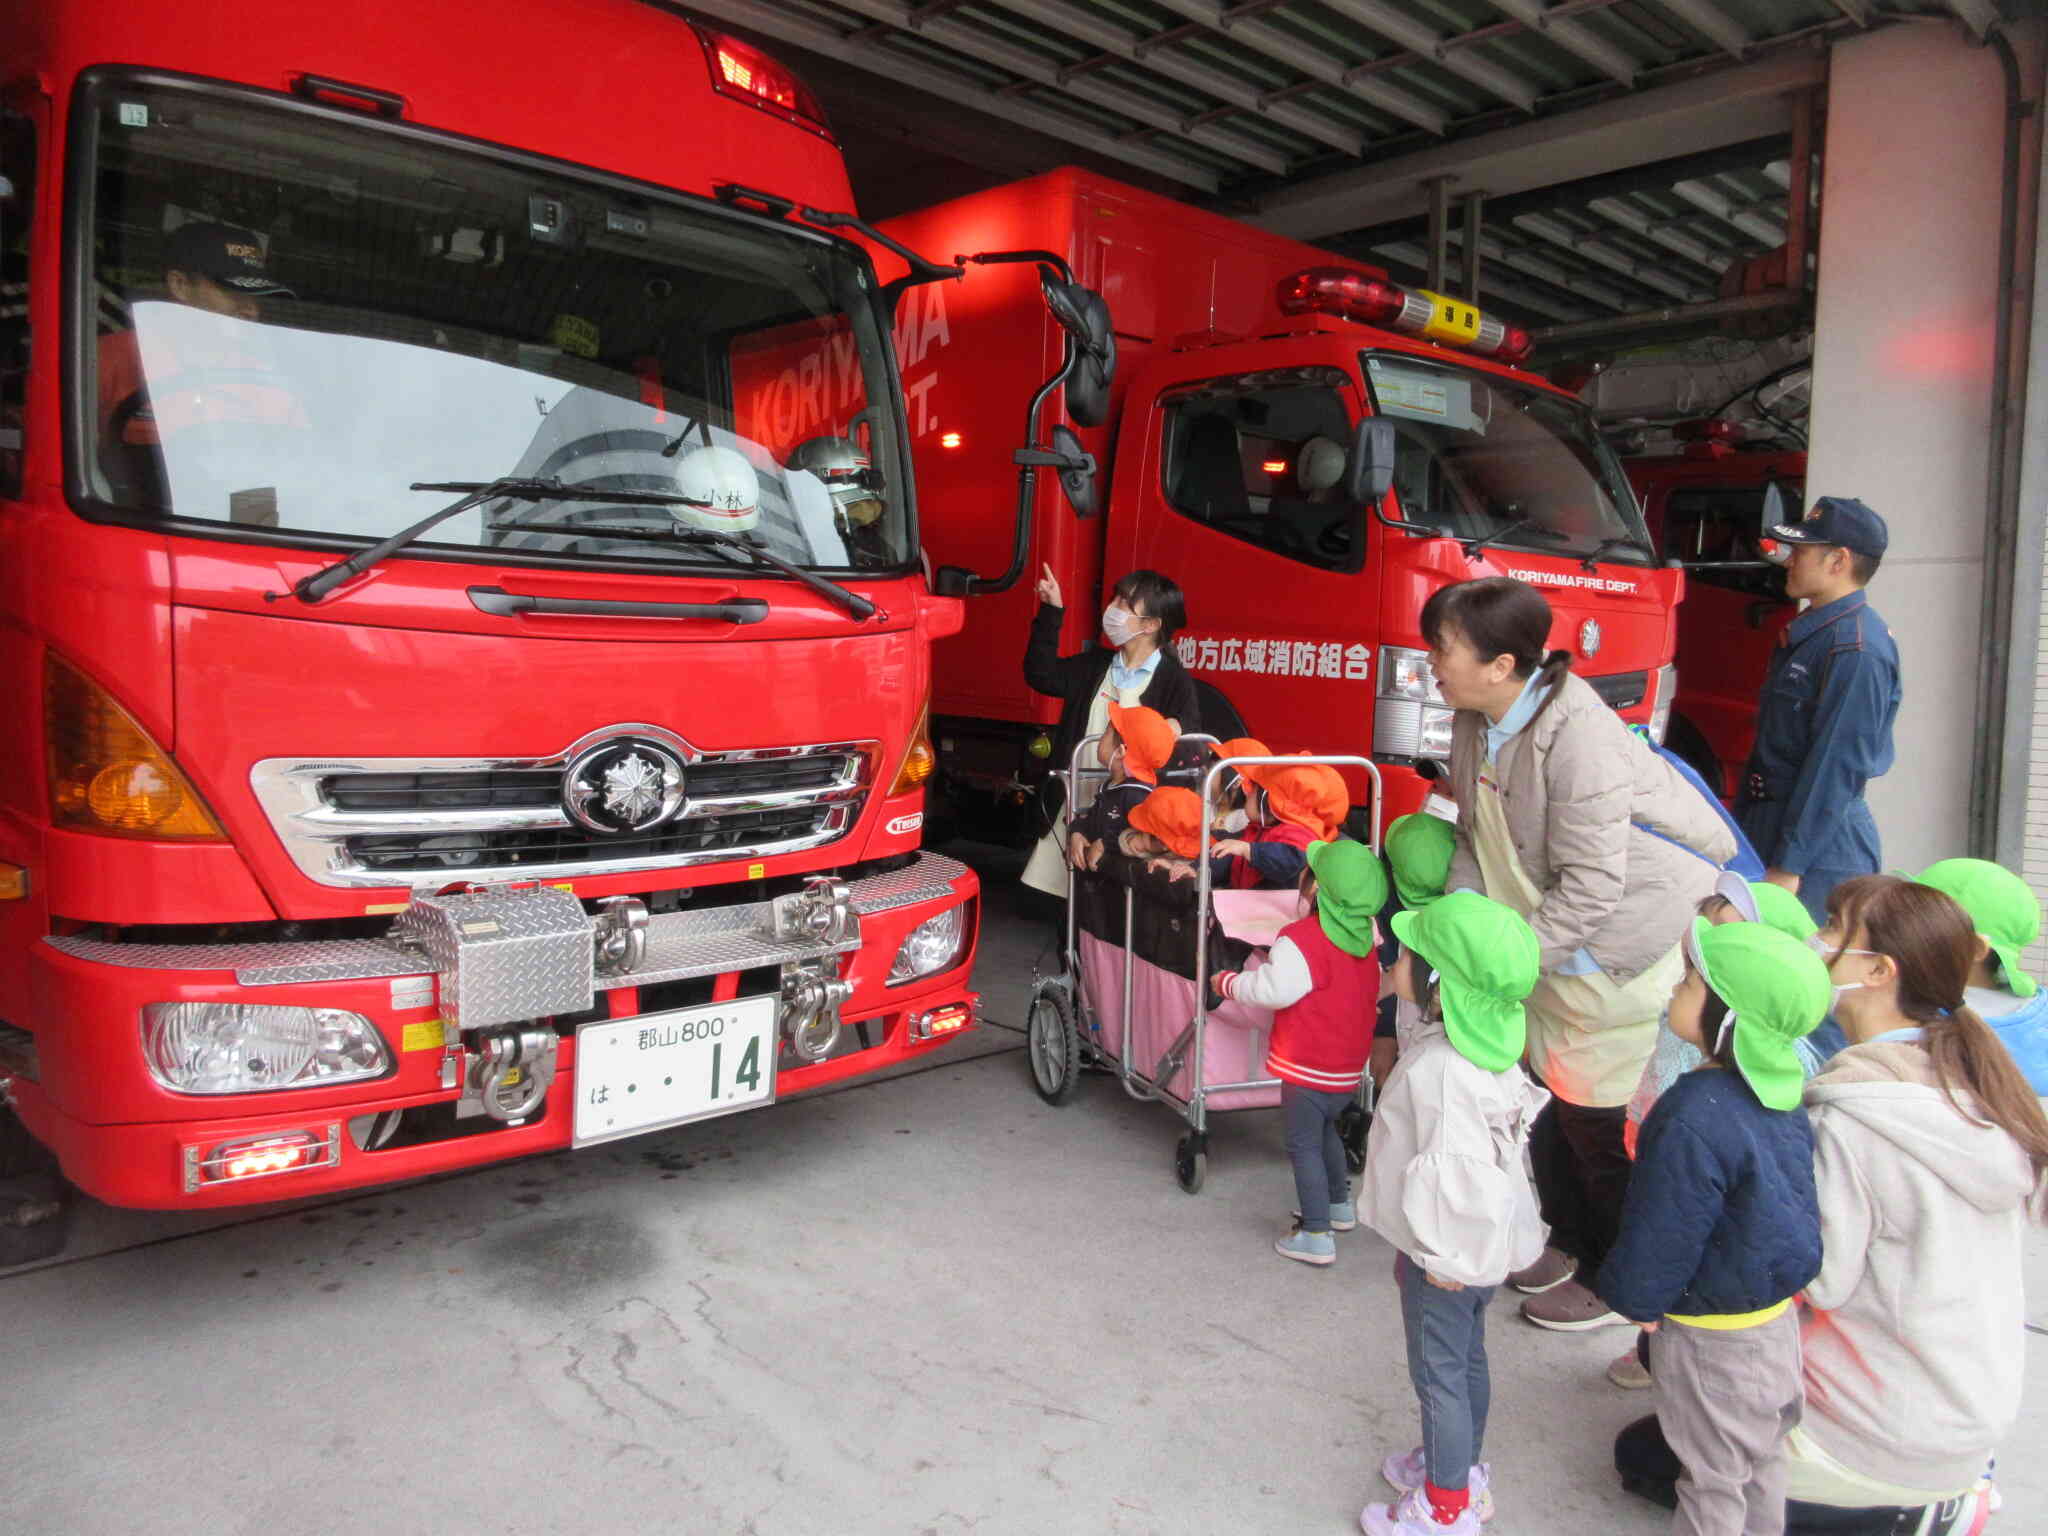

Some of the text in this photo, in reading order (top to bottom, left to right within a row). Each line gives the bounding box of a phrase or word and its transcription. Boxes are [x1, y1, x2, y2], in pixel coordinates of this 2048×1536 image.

[1507, 568, 1639, 594] KORIYAMA FIRE DEPT.
[1176, 636, 1371, 680] 地方広域消防組合
[590, 1084, 610, 1105] は
